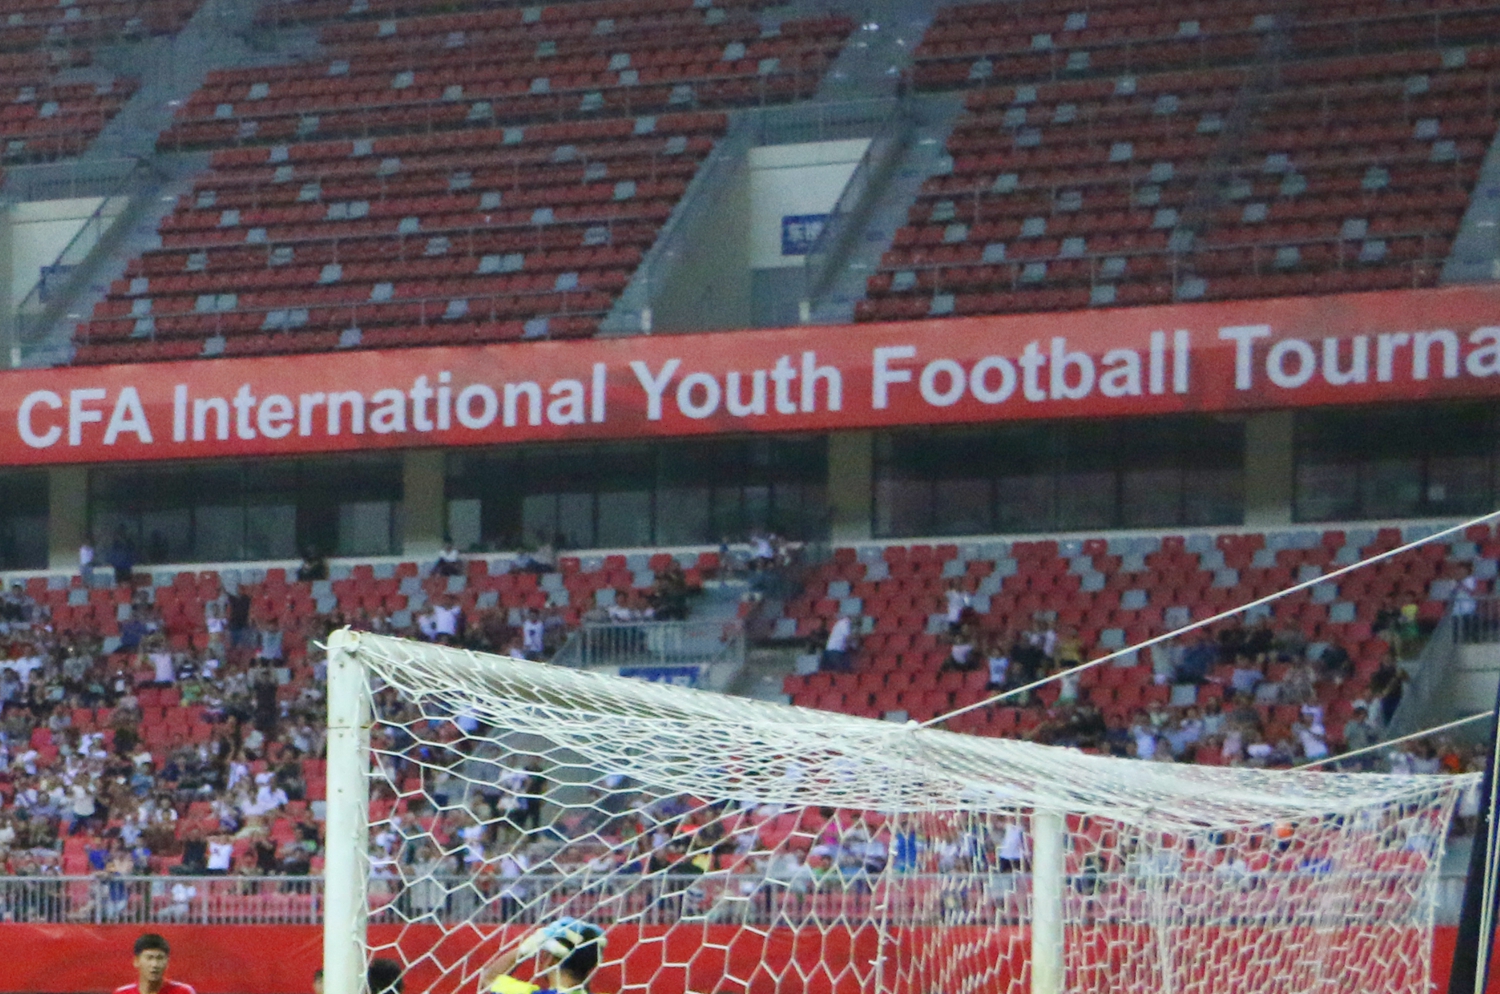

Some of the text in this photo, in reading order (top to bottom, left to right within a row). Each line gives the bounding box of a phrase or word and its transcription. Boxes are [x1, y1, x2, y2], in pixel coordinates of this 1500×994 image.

[16, 384, 153, 449] CFA
[172, 362, 607, 442] International
[628, 350, 842, 420] Youth
[872, 329, 1190, 409] Football
[1218, 324, 1500, 390] Tourna
